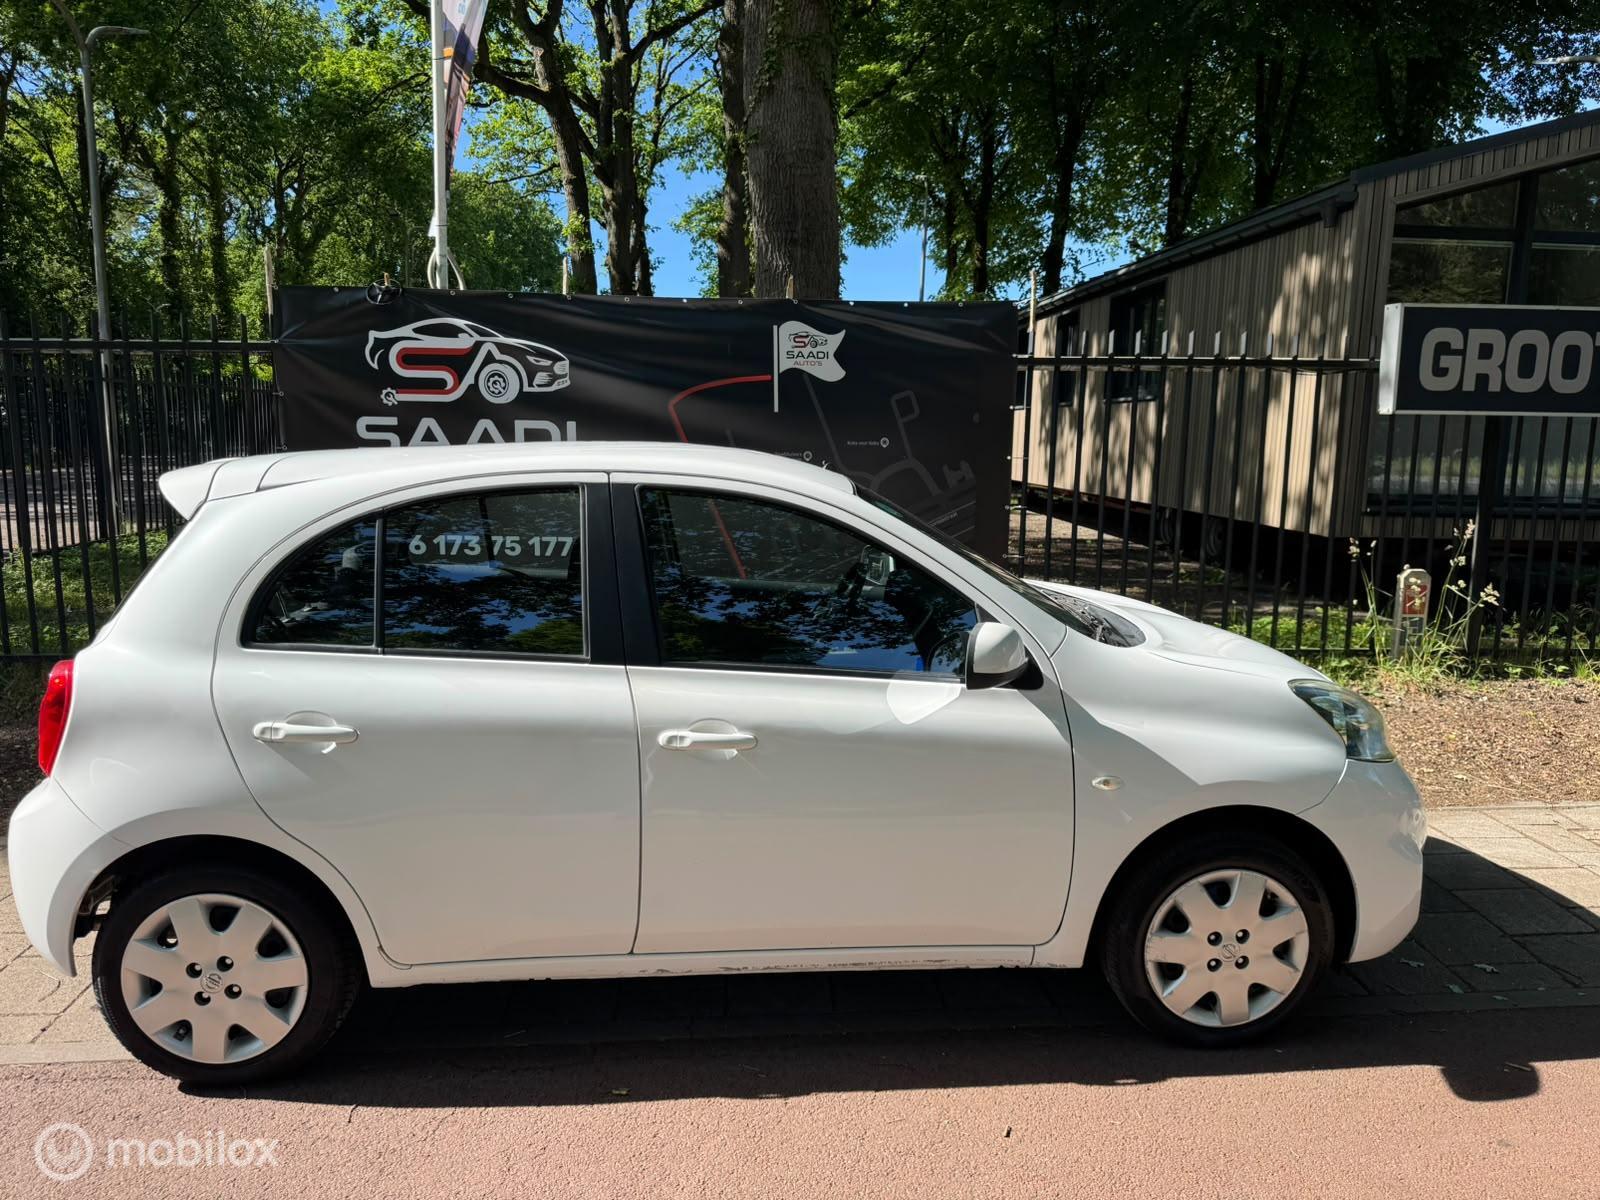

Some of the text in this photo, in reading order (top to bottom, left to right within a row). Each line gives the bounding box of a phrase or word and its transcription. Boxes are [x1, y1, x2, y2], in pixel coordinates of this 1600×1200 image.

[786, 350, 829, 360] SAADI
[1418, 326, 1600, 394] GROO
[355, 416, 577, 448] SAADI
[408, 534, 574, 558] 6 173 75 177
